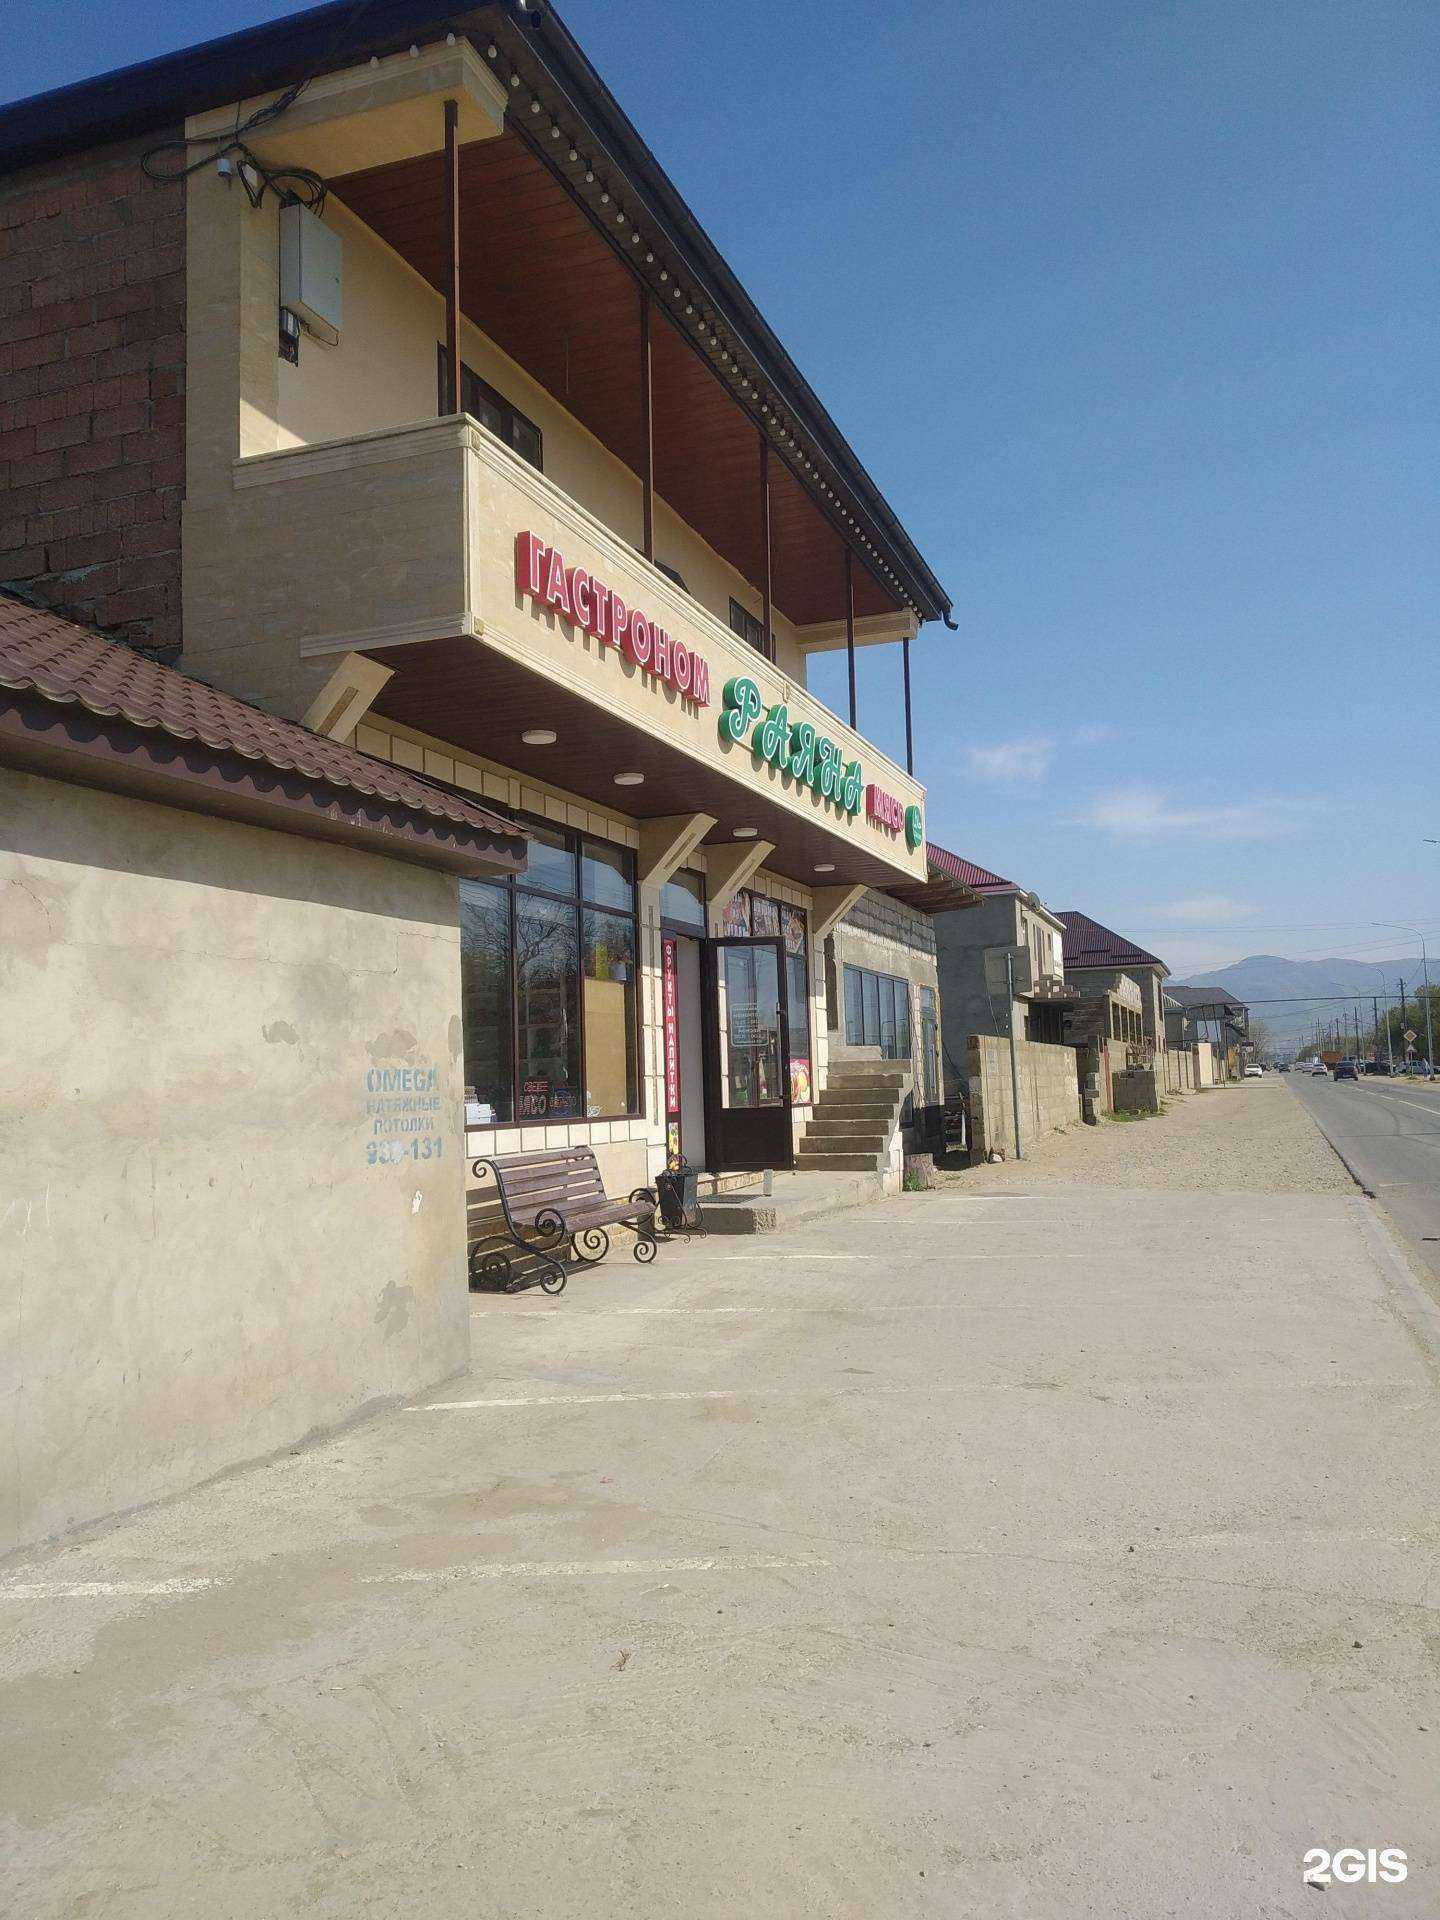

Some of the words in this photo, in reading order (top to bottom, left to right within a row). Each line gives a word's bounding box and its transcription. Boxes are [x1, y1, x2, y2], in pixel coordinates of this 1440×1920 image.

[517, 530, 712, 707] ГАСТРОНОМ
[718, 676, 864, 816] РАЯНА
[866, 784, 905, 833] МЯСО
[665, 944, 674, 1017] ФРУКТЫ
[667, 1022, 677, 1108] НАПИТКИ
